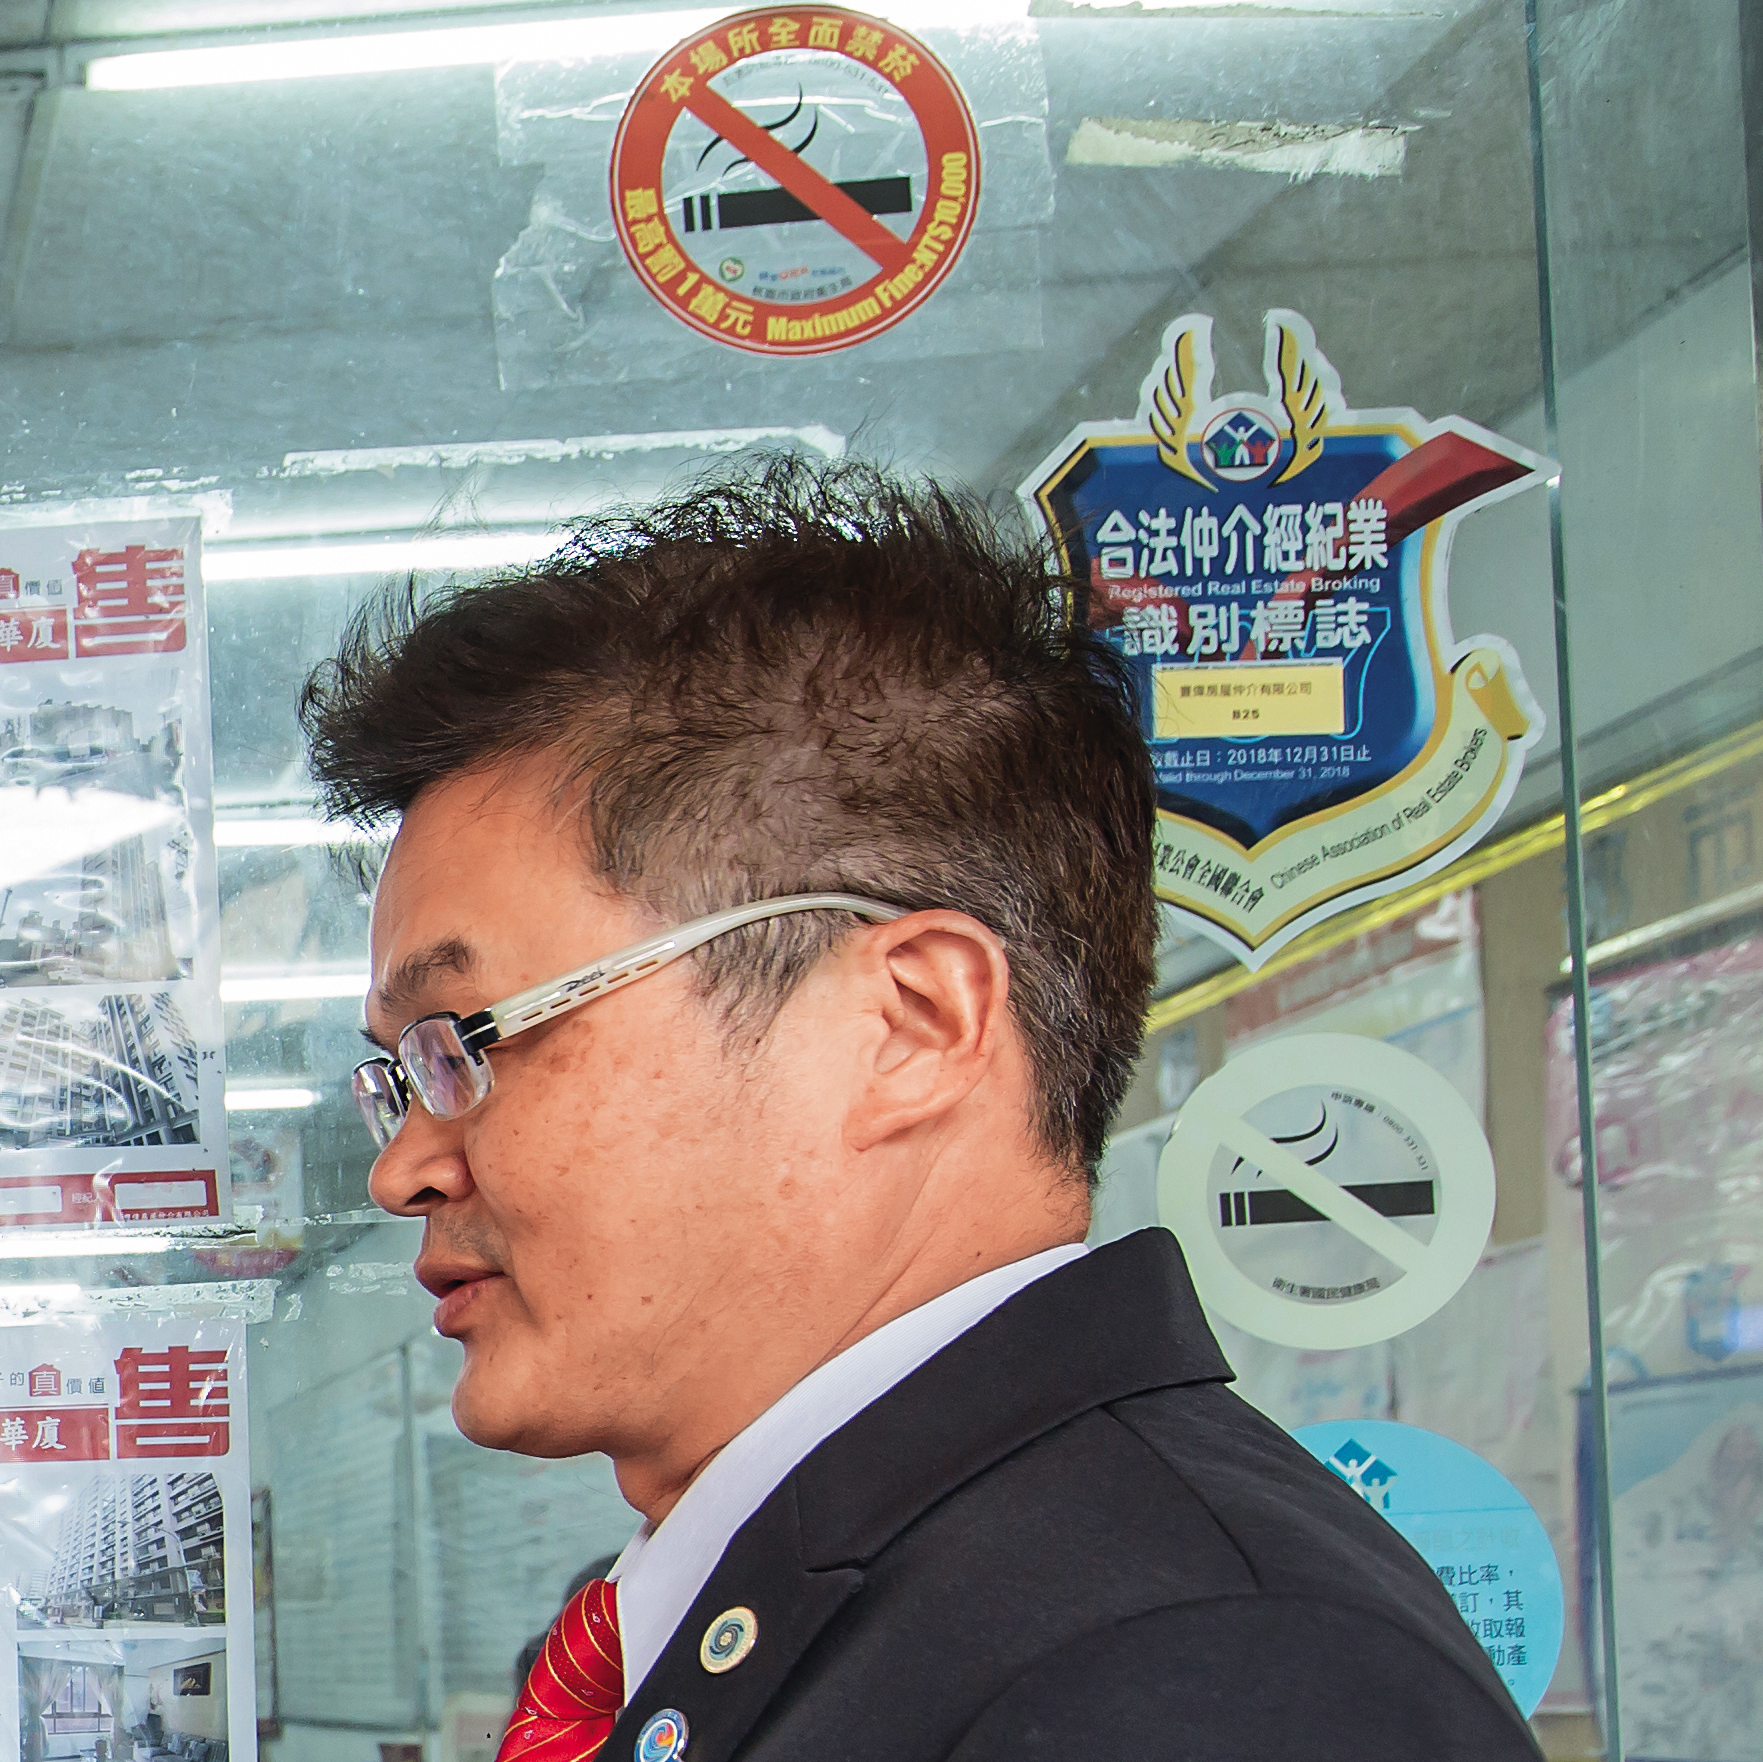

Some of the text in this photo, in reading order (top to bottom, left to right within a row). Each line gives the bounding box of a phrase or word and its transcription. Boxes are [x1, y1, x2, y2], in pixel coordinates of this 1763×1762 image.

[659, 16, 921, 104] 本場所全面禁菸
[625, 187, 756, 337] 最高罰1萬元
[766, 296, 881, 342] Maximum
[1095, 499, 1389, 580] 合法仲介經紀業
[71, 544, 187, 659] 售
[1109, 575, 1381, 601] Registered Real Estate Broking
[1122, 597, 1372, 657] 識別標誌
[1186, 771, 1232, 784] through
[1234, 769, 1295, 782] December
[1320, 767, 1350, 778] 2018
[1271, 727, 1488, 890] Chinese Association of Real Estate Brokers
[114, 1345, 229, 1459] 售
